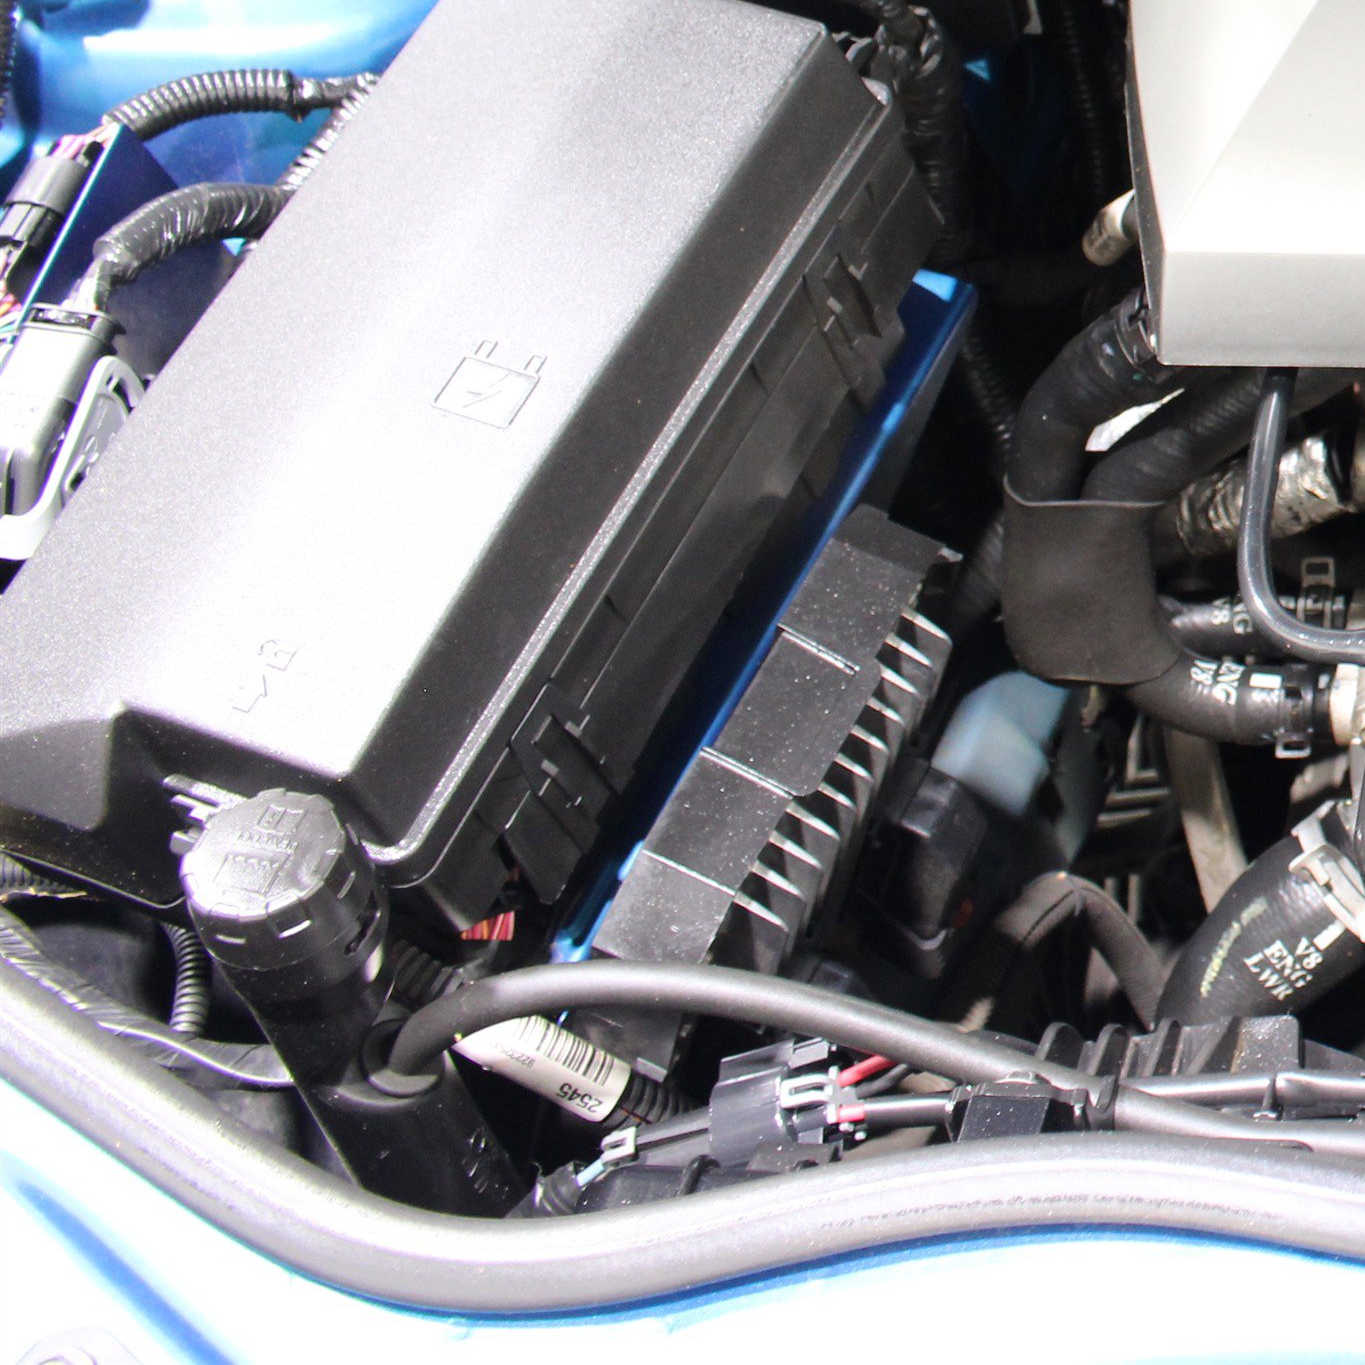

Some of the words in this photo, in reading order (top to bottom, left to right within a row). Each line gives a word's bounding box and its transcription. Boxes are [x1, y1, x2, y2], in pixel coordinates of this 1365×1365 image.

[1189, 658, 1219, 686] V8
[1262, 939, 1313, 988] ENG
[1293, 936, 1323, 970] V8
[1242, 951, 1294, 1001] LWR
[556, 1081, 604, 1114] 2545
